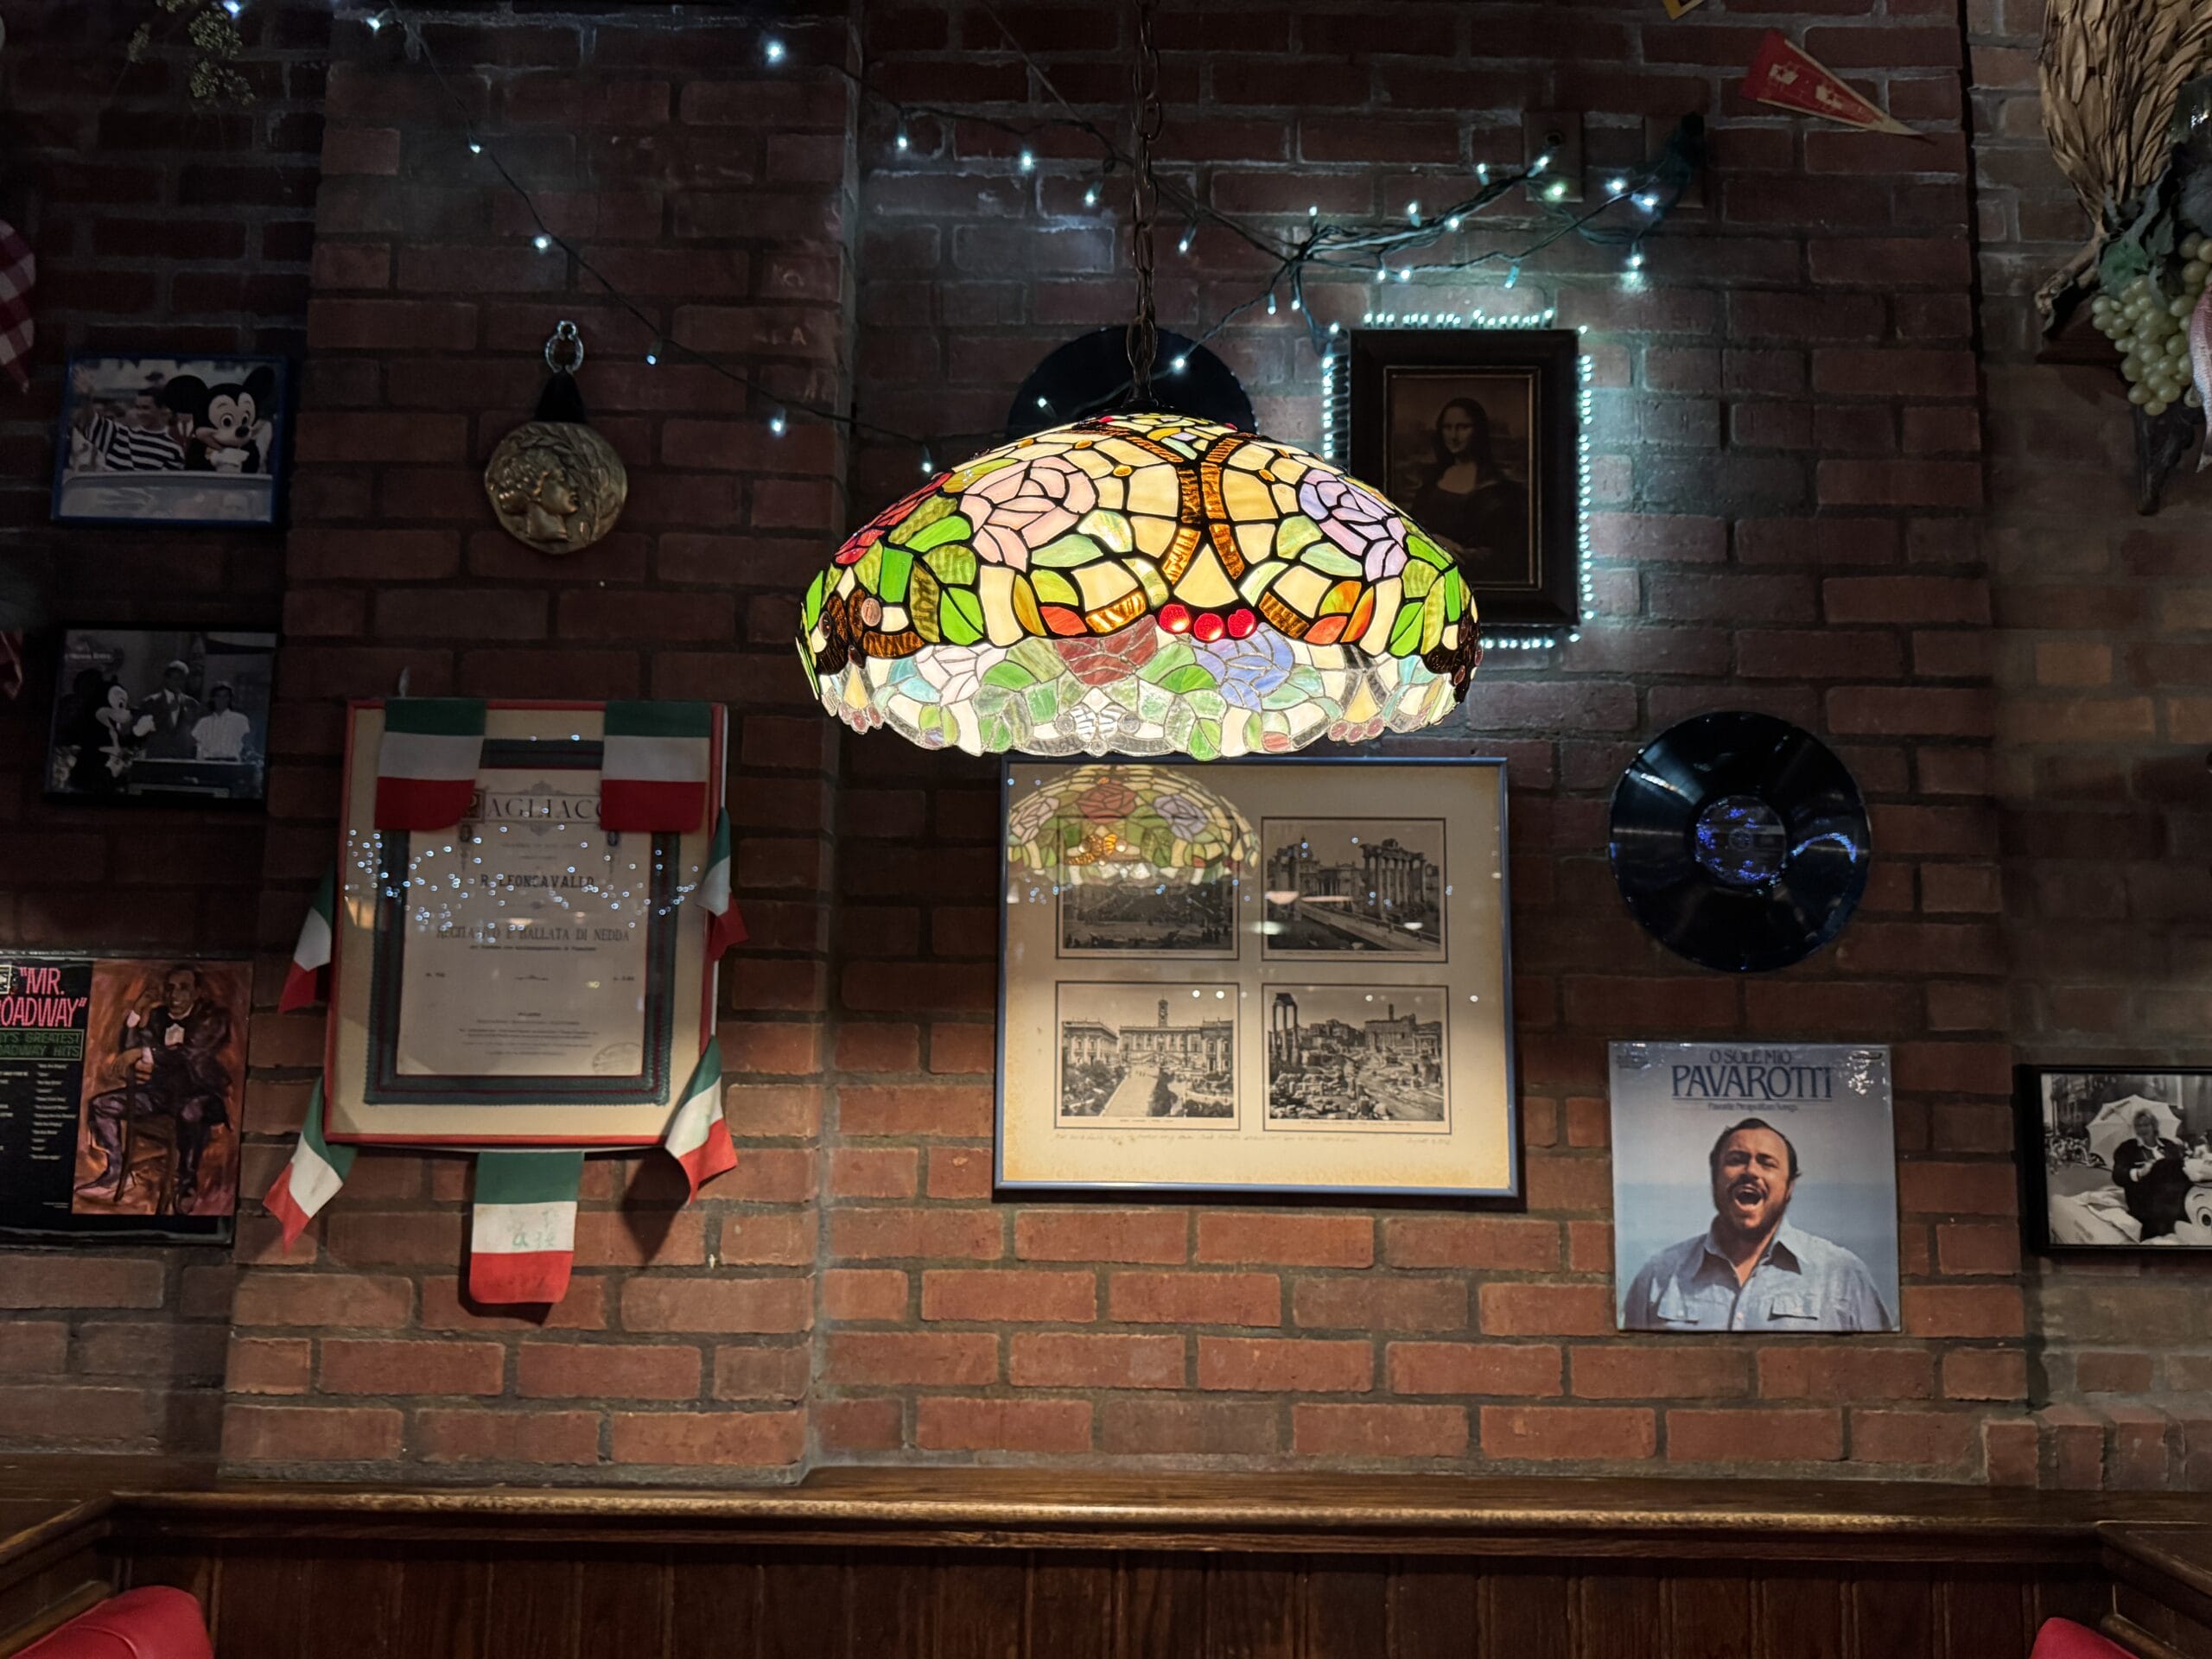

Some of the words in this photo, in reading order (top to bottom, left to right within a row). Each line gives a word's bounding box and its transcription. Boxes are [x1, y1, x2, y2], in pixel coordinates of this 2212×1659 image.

[575, 928, 588, 940] DI
[594, 928, 630, 942] NEDDA
[20, 967, 65, 995] "MR.
[0, 996, 87, 1027] OADWAY"
[25, 1032, 79, 1045] GREATEST
[54, 1046, 80, 1057] HITS
[1709, 1049, 1720, 1064] O
[1724, 1049, 1762, 1065] SOLE
[1765, 1049, 1791, 1065] MIO
[1671, 1065, 1833, 1100] PAVAROTTI
